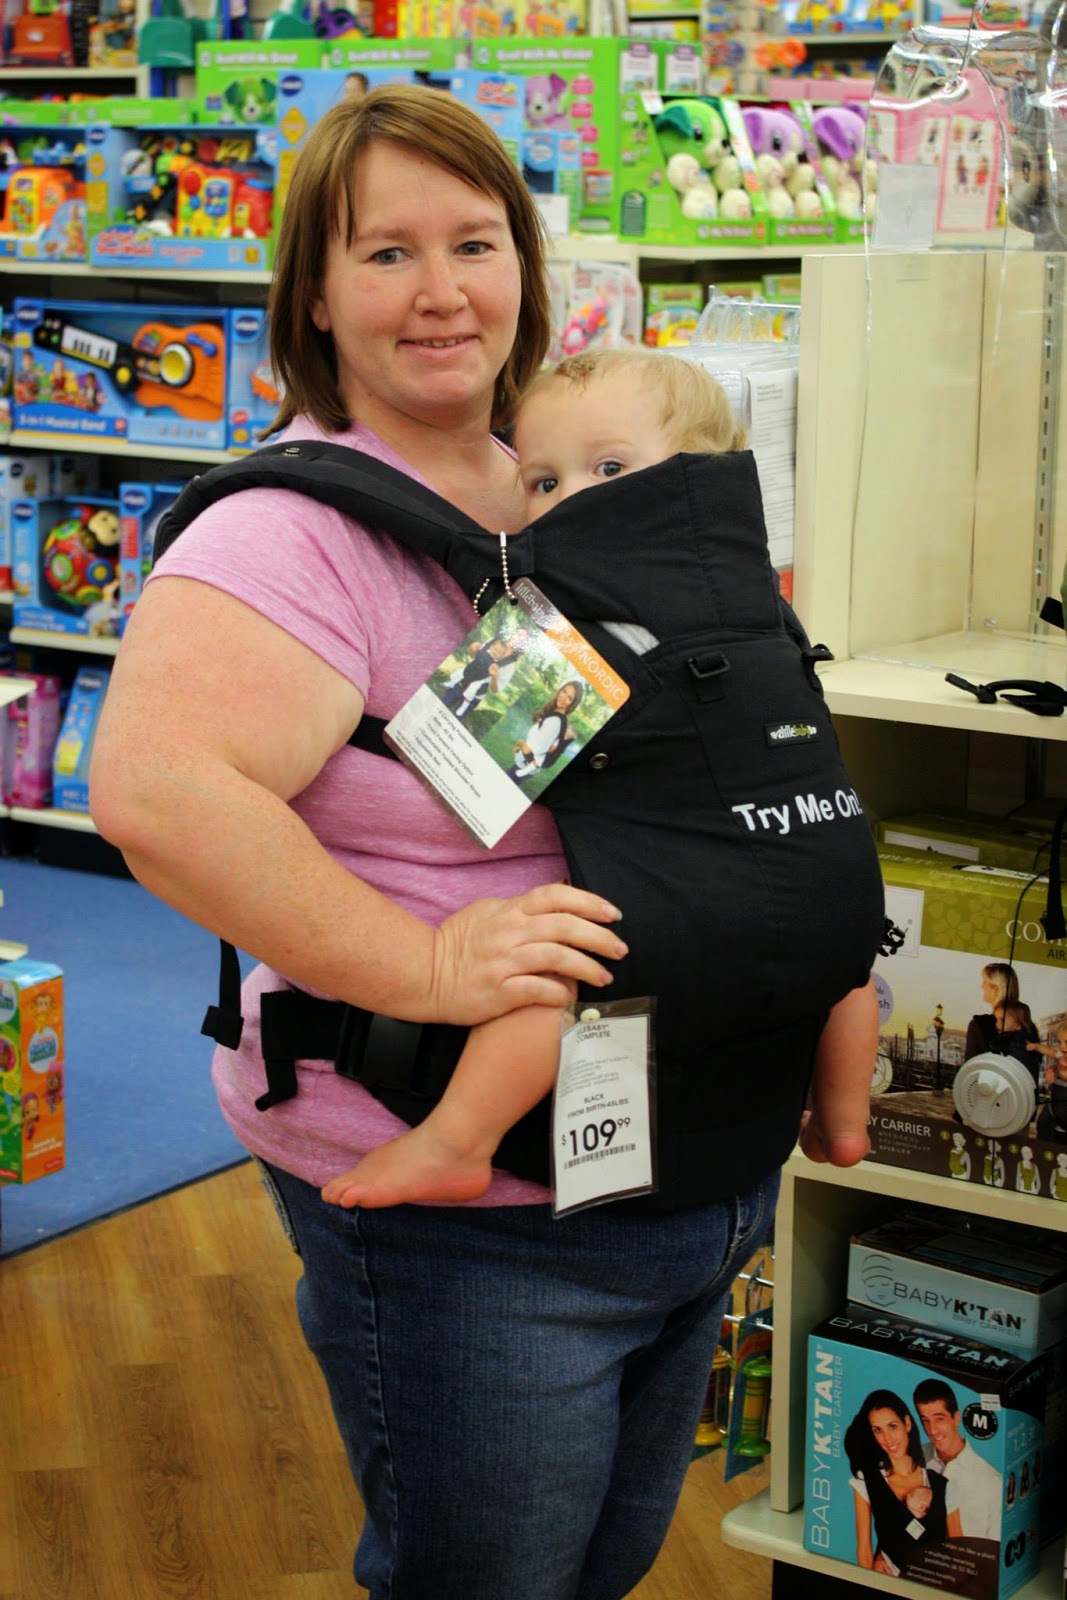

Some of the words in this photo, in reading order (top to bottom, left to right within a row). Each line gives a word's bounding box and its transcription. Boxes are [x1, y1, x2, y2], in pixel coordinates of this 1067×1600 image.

[732, 803, 790, 834] Try
[795, 793, 835, 824] Me
[584, 1094, 604, 1104] BLACK
[881, 1118, 931, 1137] CARRIER
[952, 1313, 977, 1327] BABY
[980, 1320, 1021, 1337] CARRIER
[833, 1355, 844, 1417] CARRIER
[973, 1413, 988, 1430] M
[833, 1421, 842, 1459] BABY
